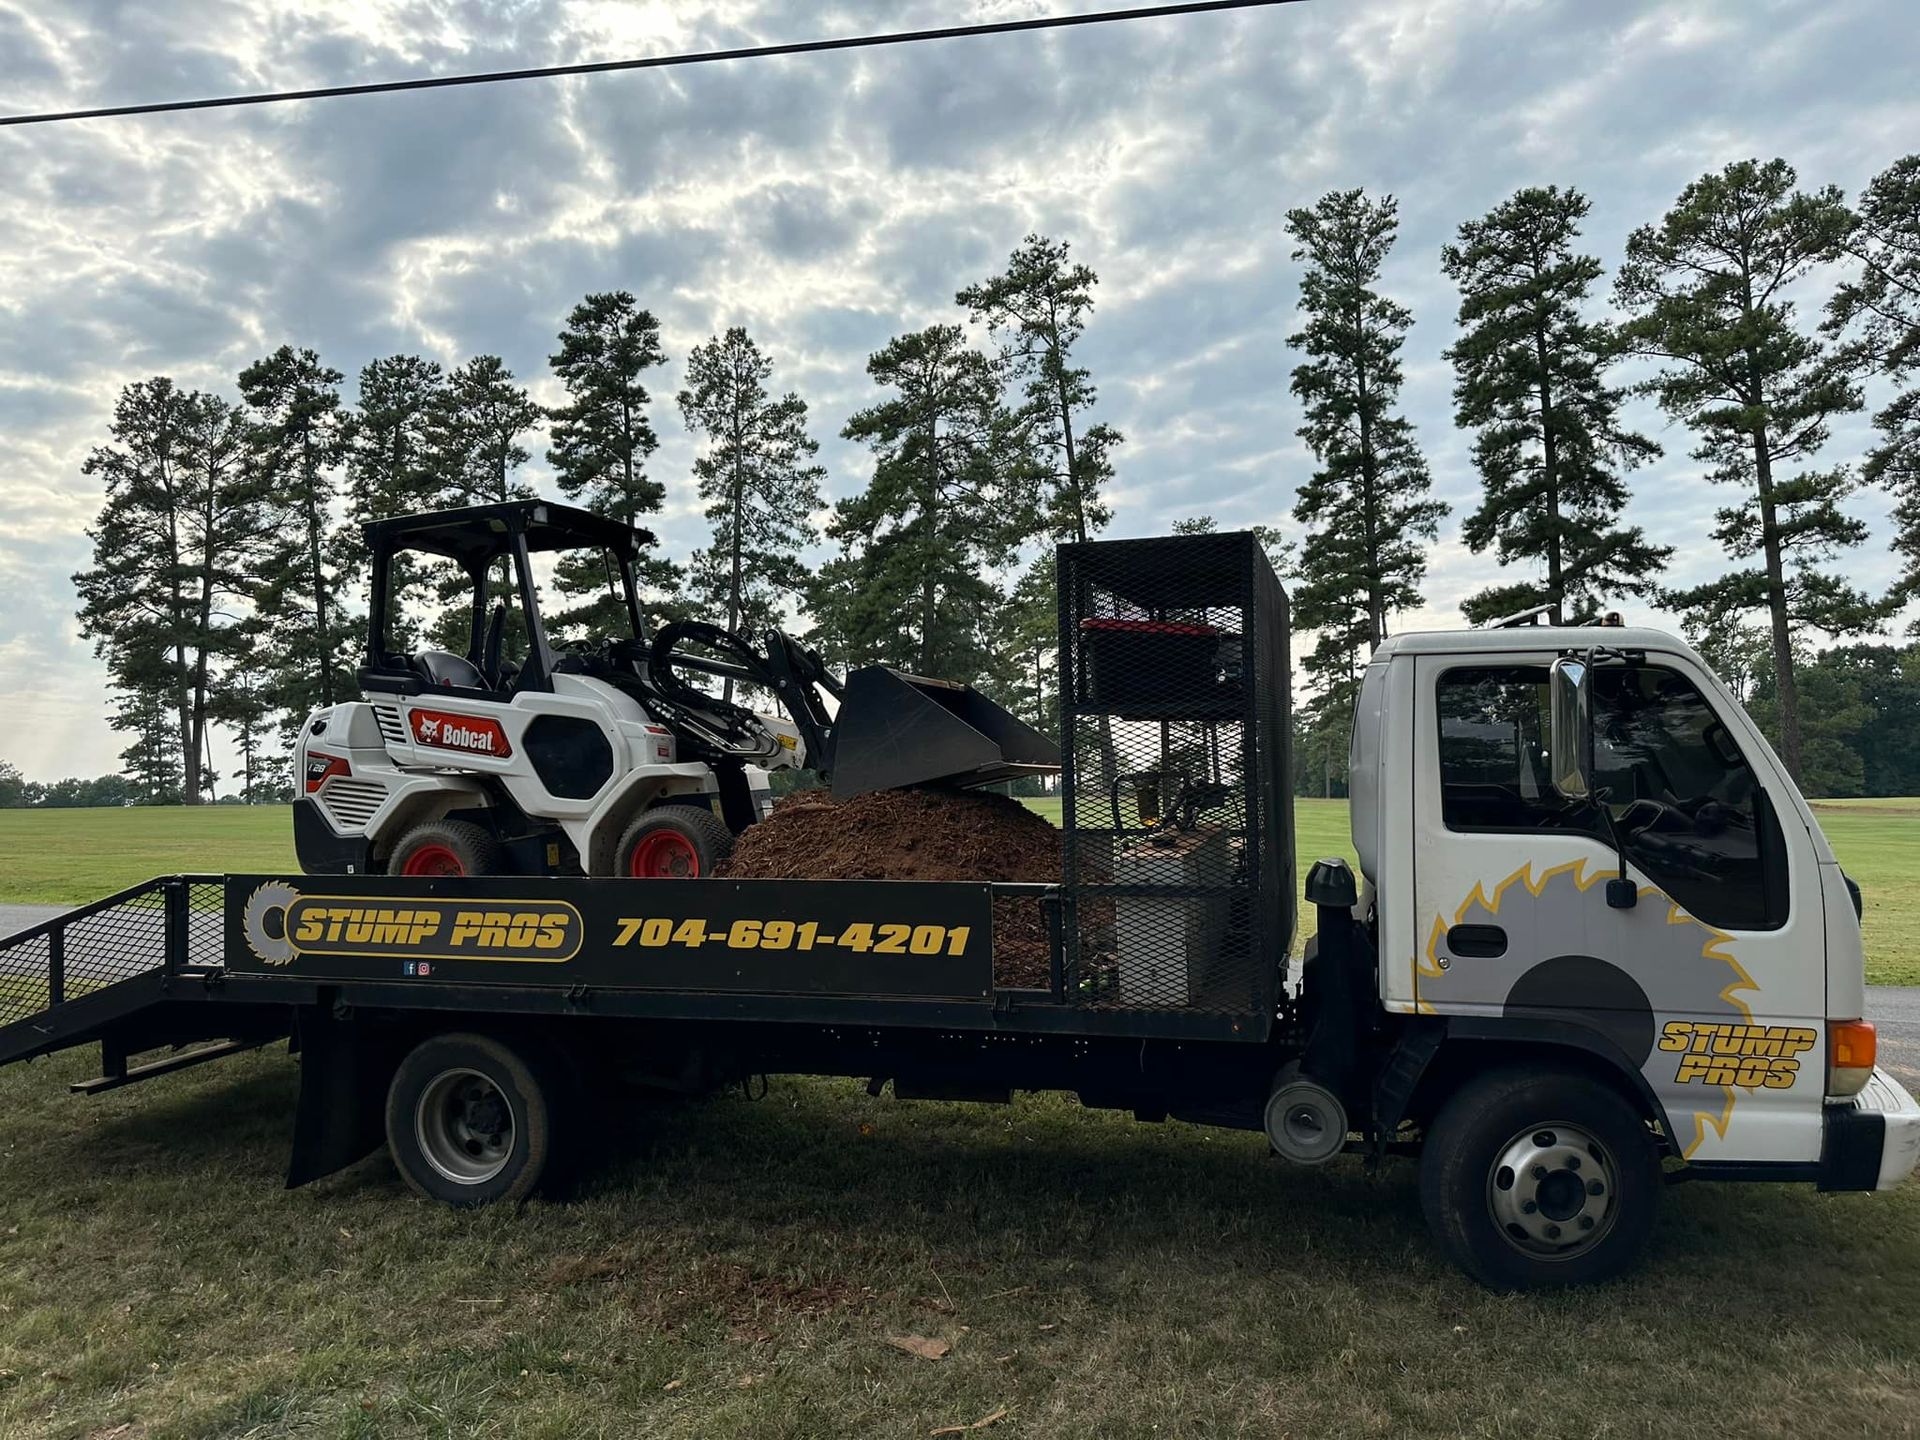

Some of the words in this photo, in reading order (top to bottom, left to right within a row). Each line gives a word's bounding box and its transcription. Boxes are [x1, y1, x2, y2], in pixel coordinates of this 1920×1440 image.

[442, 723, 494, 751] Bobcat
[295, 907, 442, 945] STUMP
[449, 911, 570, 949] PROS
[611, 918, 971, 956] 704-691-4201
[1658, 1021, 1818, 1057] STUMP
[1674, 1053, 1801, 1089] PROS
